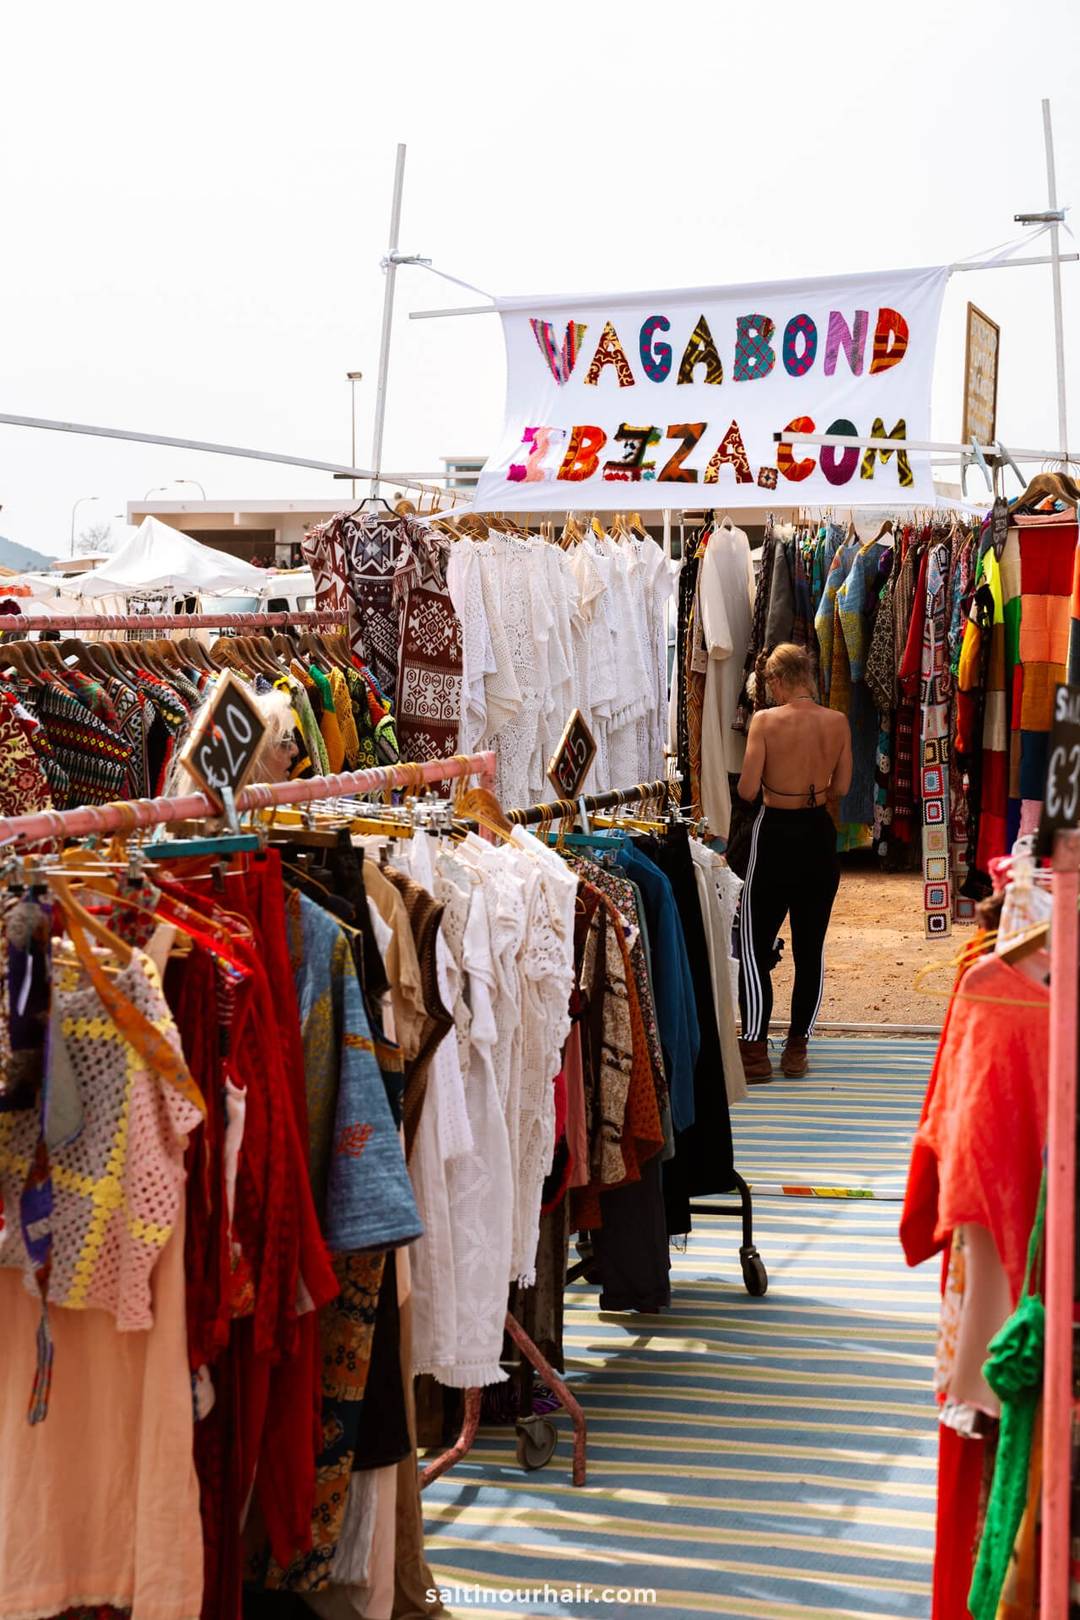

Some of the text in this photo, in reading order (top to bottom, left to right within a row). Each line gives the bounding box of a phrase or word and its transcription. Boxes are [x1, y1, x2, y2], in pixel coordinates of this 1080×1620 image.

[530, 308, 909, 387] VAGABOND
[507, 417, 914, 489] IBIZA.COM
[201, 704, 251, 787] €20
[559, 727, 586, 791] €15
